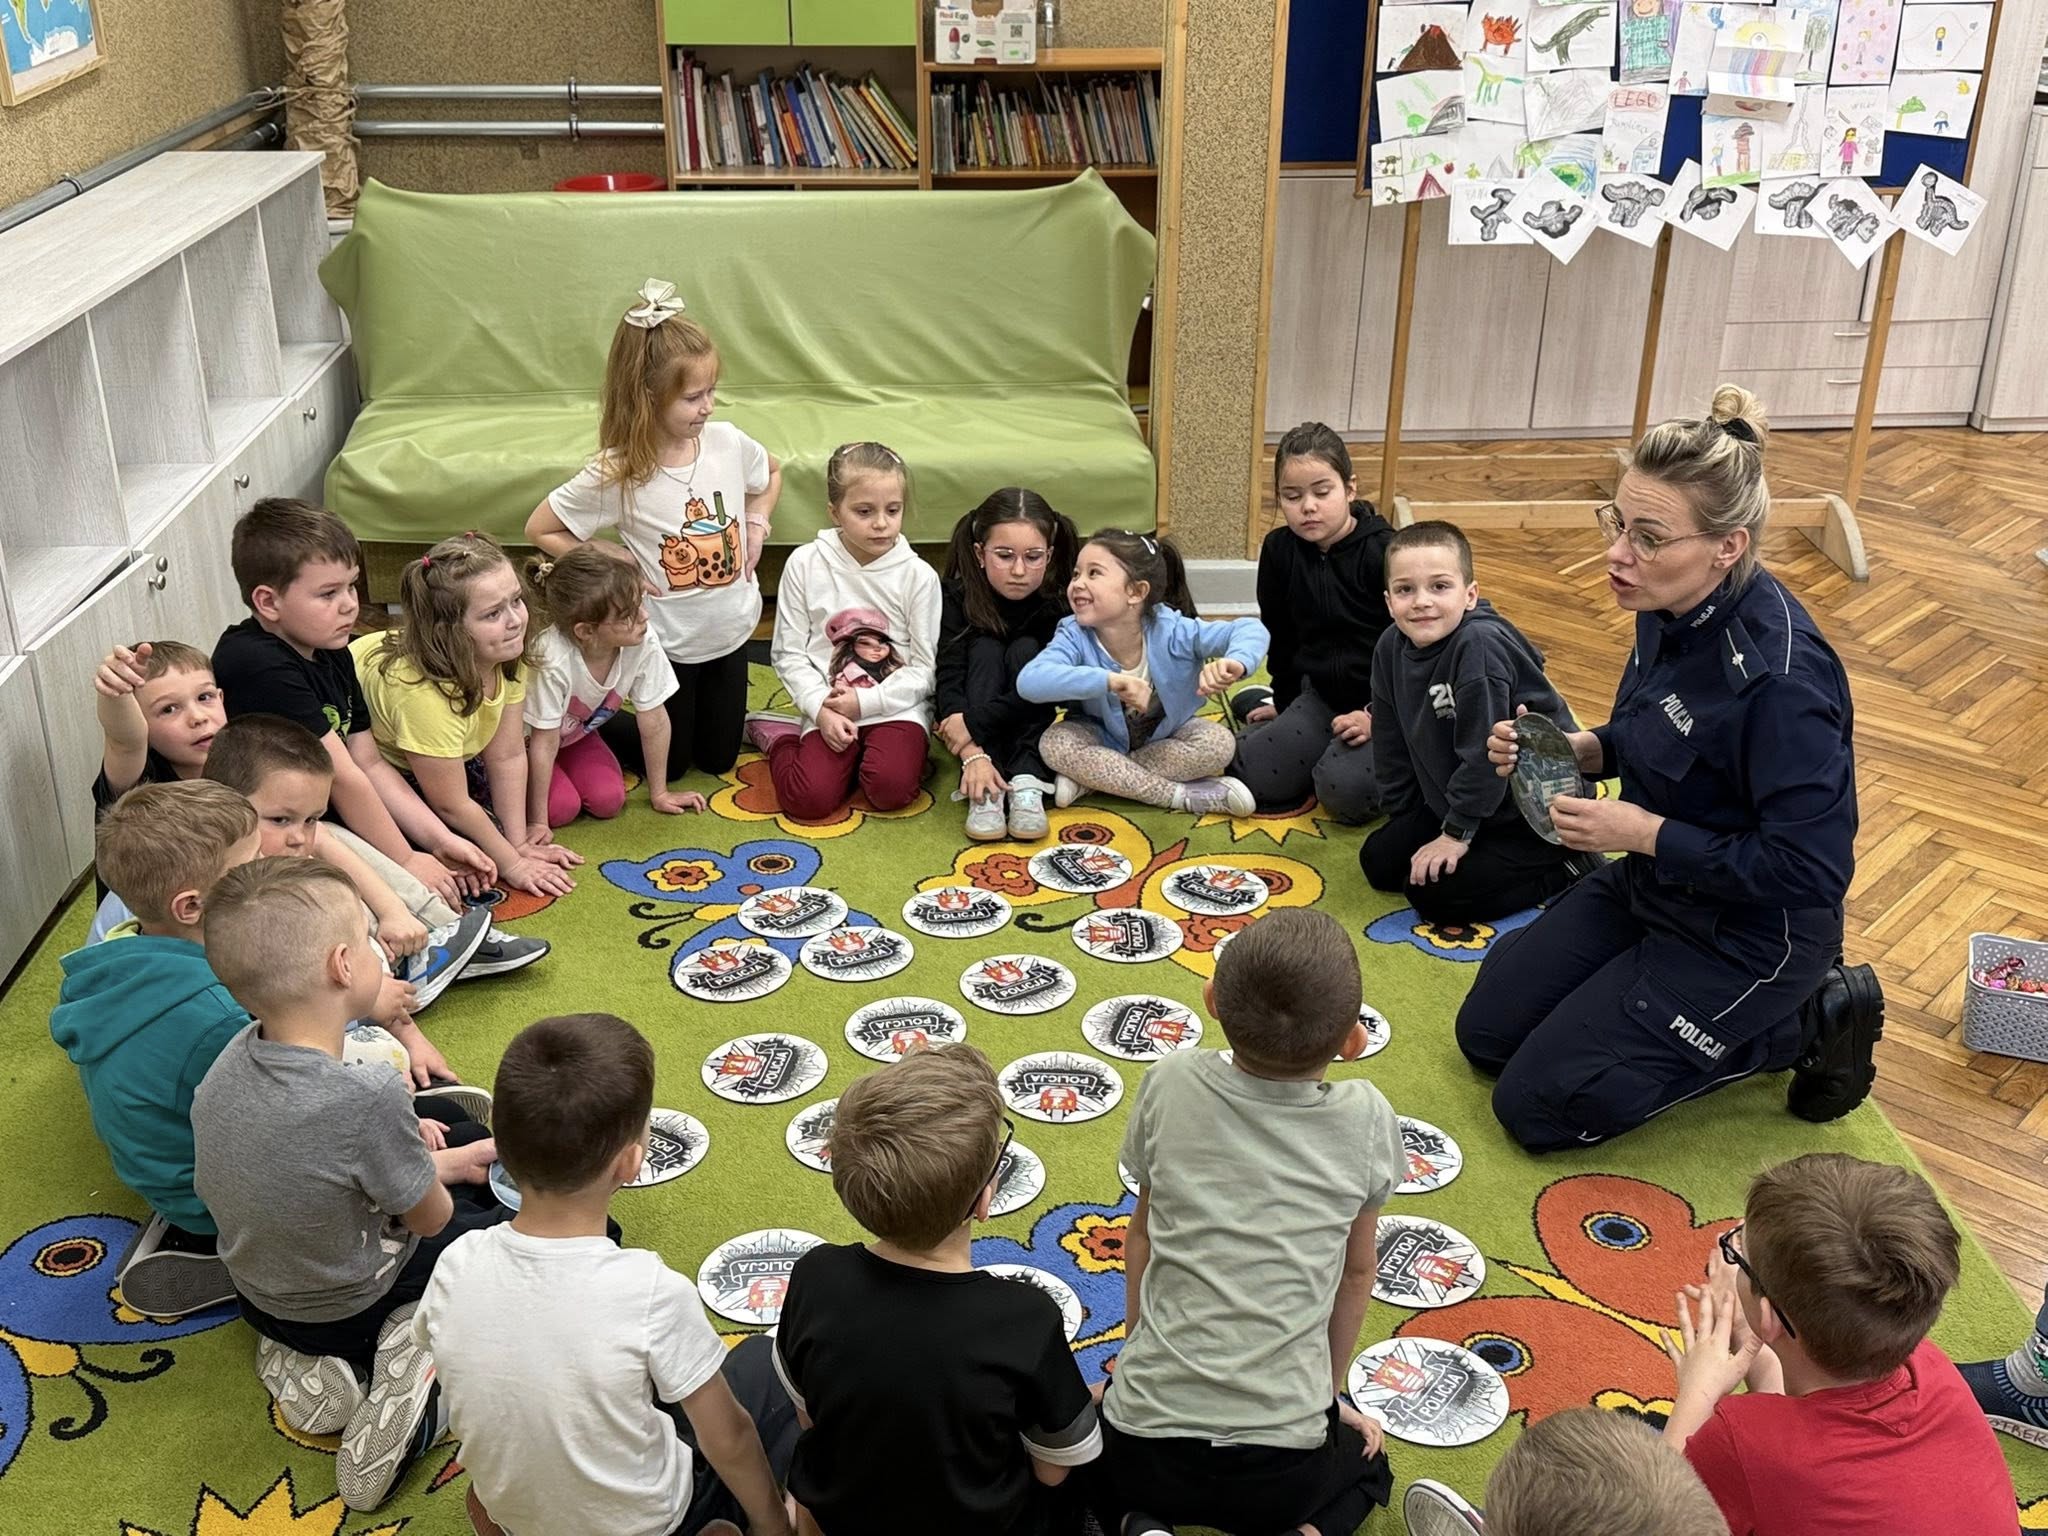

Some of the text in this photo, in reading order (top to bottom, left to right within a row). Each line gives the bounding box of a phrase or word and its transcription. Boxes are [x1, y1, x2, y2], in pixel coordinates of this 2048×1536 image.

[1614, 91, 1658, 108] LEGO
[1690, 605, 1717, 629] POLICJA
[1659, 693, 1695, 737] POLICJA
[1058, 858, 1086, 880] POLICJA
[1188, 884, 1232, 902] POLICJA
[779, 904, 821, 925] POLICJA
[934, 911, 985, 920] POLICJA
[836, 948, 887, 965] POLICJA
[714, 963, 765, 986] POLICJA
[1000, 977, 1049, 998] POLICJA
[876, 1016, 932, 1029] POLICJA
[1120, 1010, 1143, 1041] POLICJA
[1669, 1014, 1727, 1061] POLICJA
[763, 1051, 789, 1086] POLICJA
[1030, 1074, 1089, 1084] POLICJA
[1379, 1236, 1418, 1275] POLICJA
[737, 1260, 795, 1273] OLICJA
[1419, 1374, 1464, 1418] POLICJA
